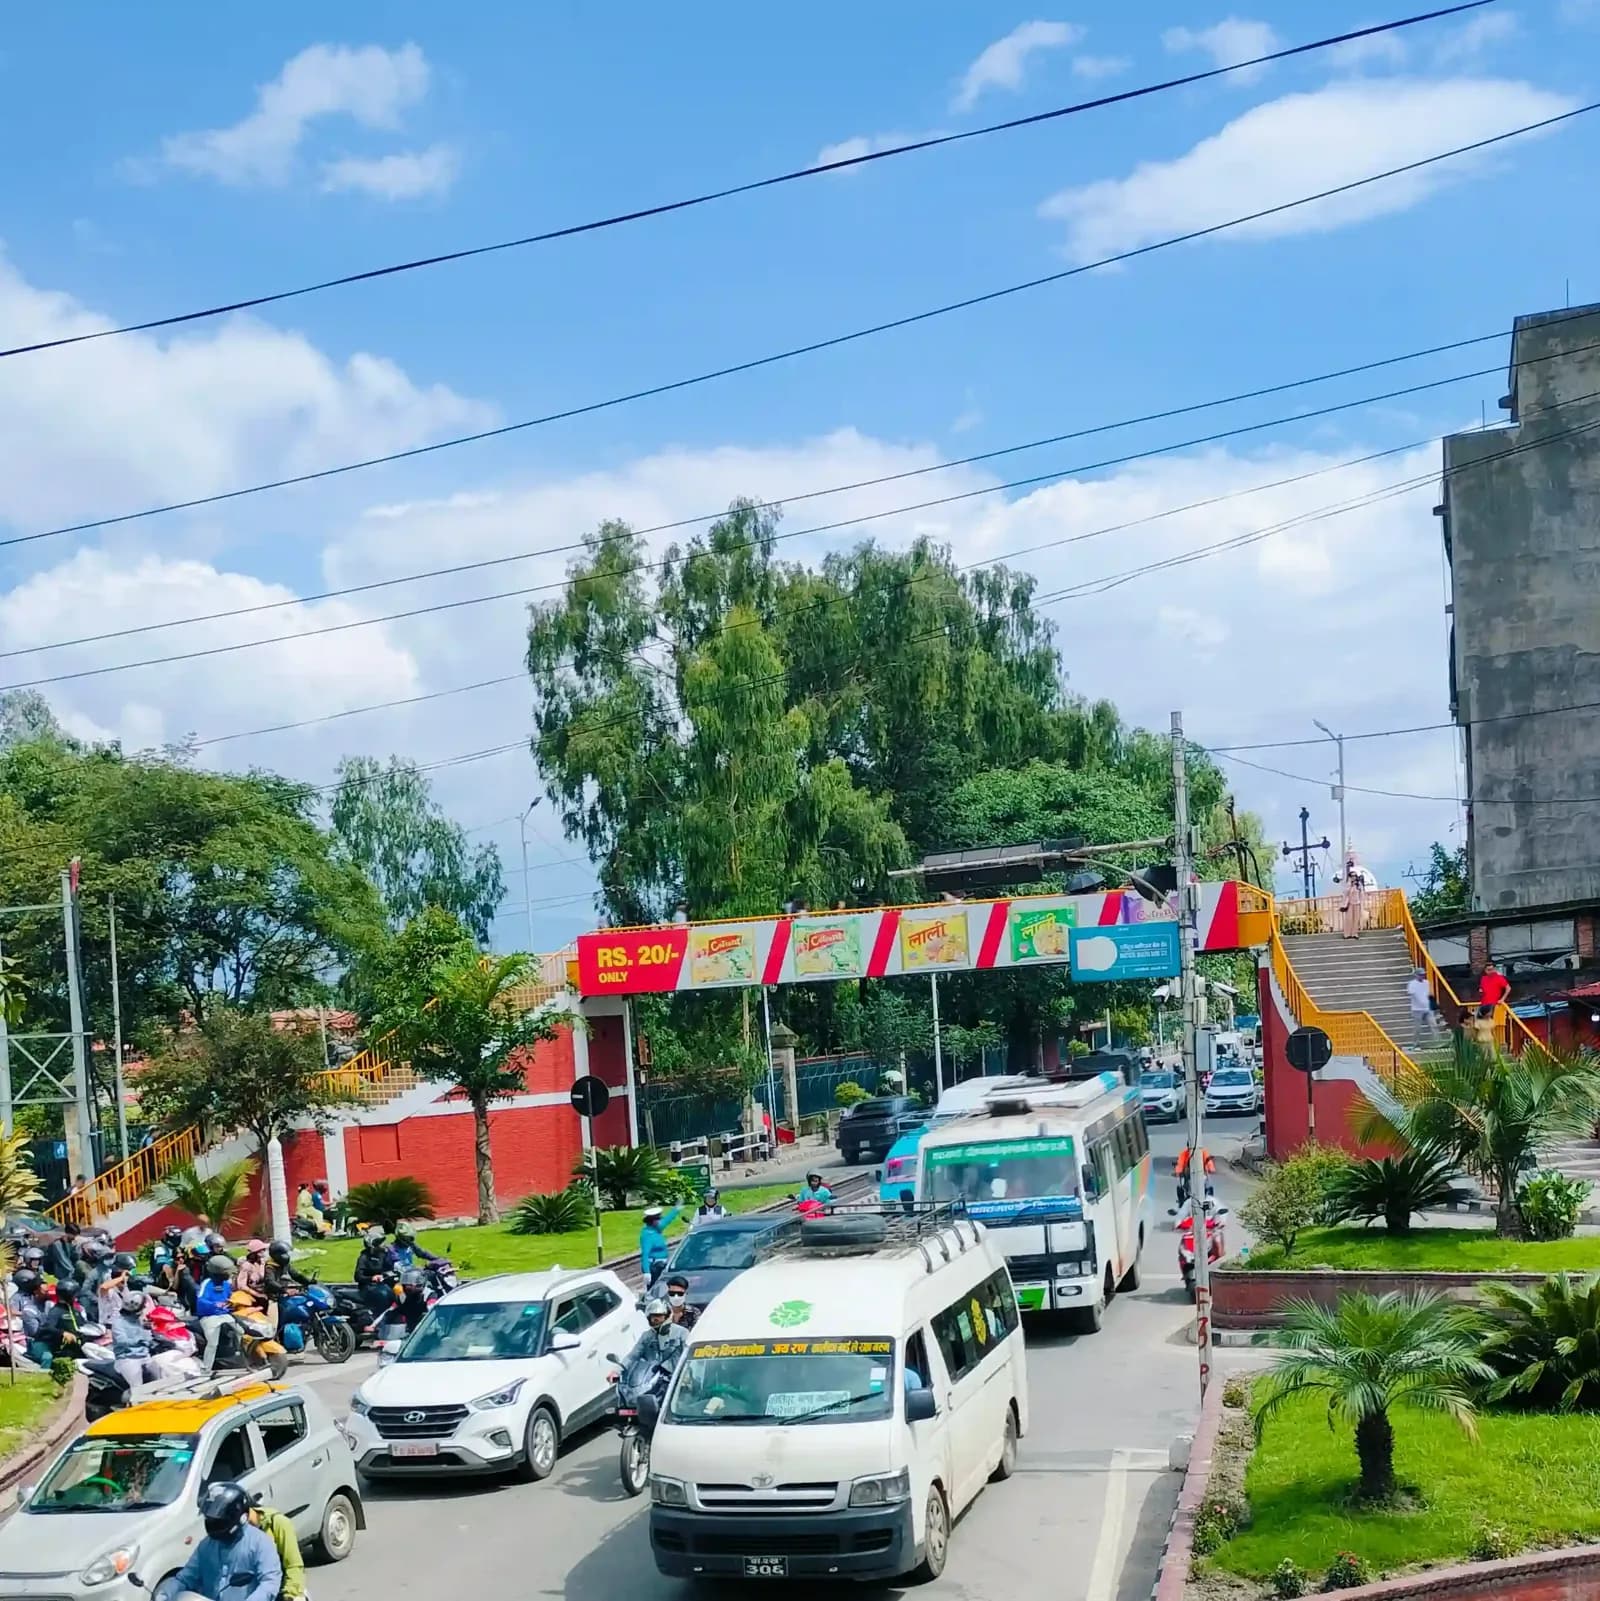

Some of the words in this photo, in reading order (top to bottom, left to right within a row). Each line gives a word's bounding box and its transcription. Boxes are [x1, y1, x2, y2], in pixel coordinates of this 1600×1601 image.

[908, 920, 947, 949] लाली
[597, 947, 634, 968] RS.
[638, 943, 680, 966] 20/-
[598, 971, 628, 984] ONLY
